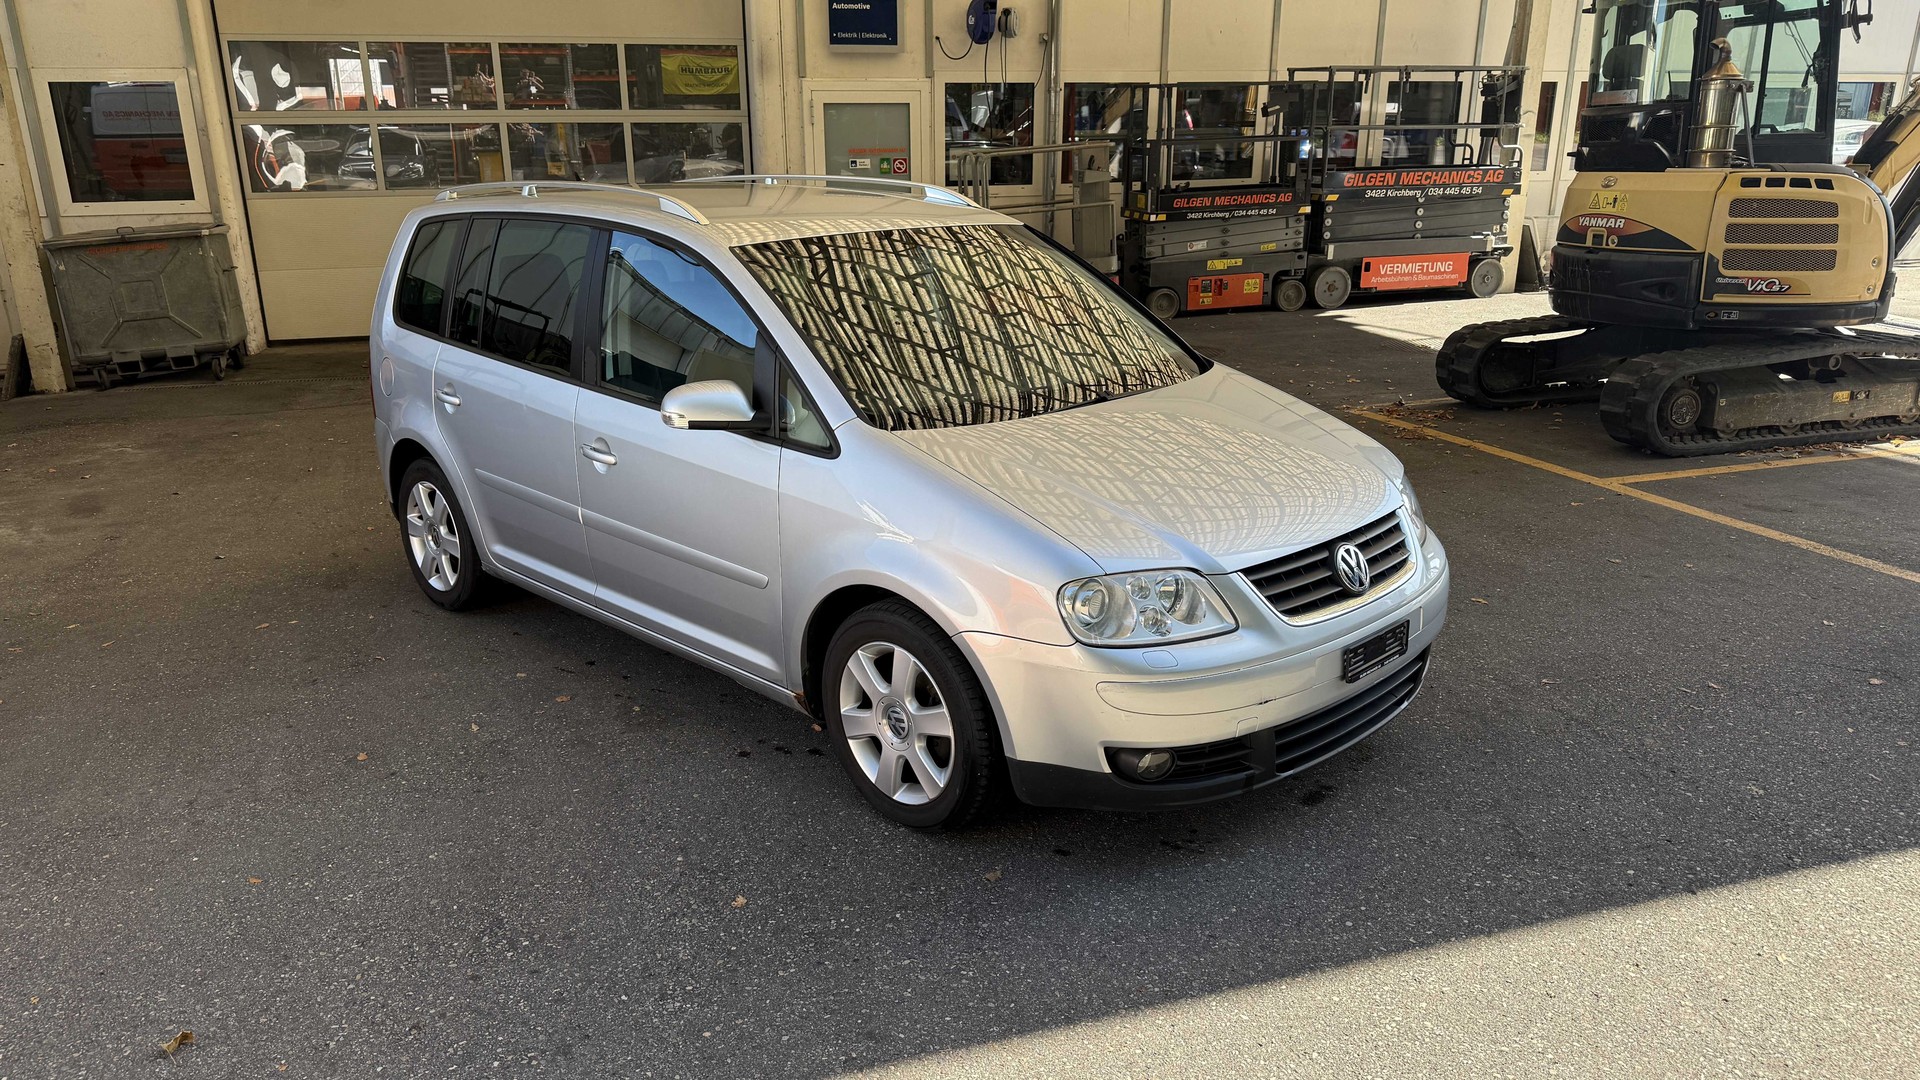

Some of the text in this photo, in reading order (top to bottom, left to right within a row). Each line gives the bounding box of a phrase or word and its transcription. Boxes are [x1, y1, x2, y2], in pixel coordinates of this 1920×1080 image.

[680, 66, 731, 74] HUMBAUR
[1343, 169, 1504, 188] GILGEN MECHANICS AG
[1365, 189, 1386, 198] 3422
[1386, 188, 1422, 198] Kirchberg
[1428, 187, 1444, 196] 034
[1444, 187, 1460, 195] 445
[1461, 187, 1472, 195] 45
[1472, 186, 1483, 194] 54
[1173, 192, 1293, 208] GILGEN MECHANICS AG
[1203, 211, 1229, 219] Kirchberg
[1578, 216, 1626, 229] YANMAR
[1380, 261, 1454, 275] VERMIETUNG
[1370, 275, 1413, 283] Arbeitsbühnen
[1418, 273, 1459, 281] Baumaschinen
